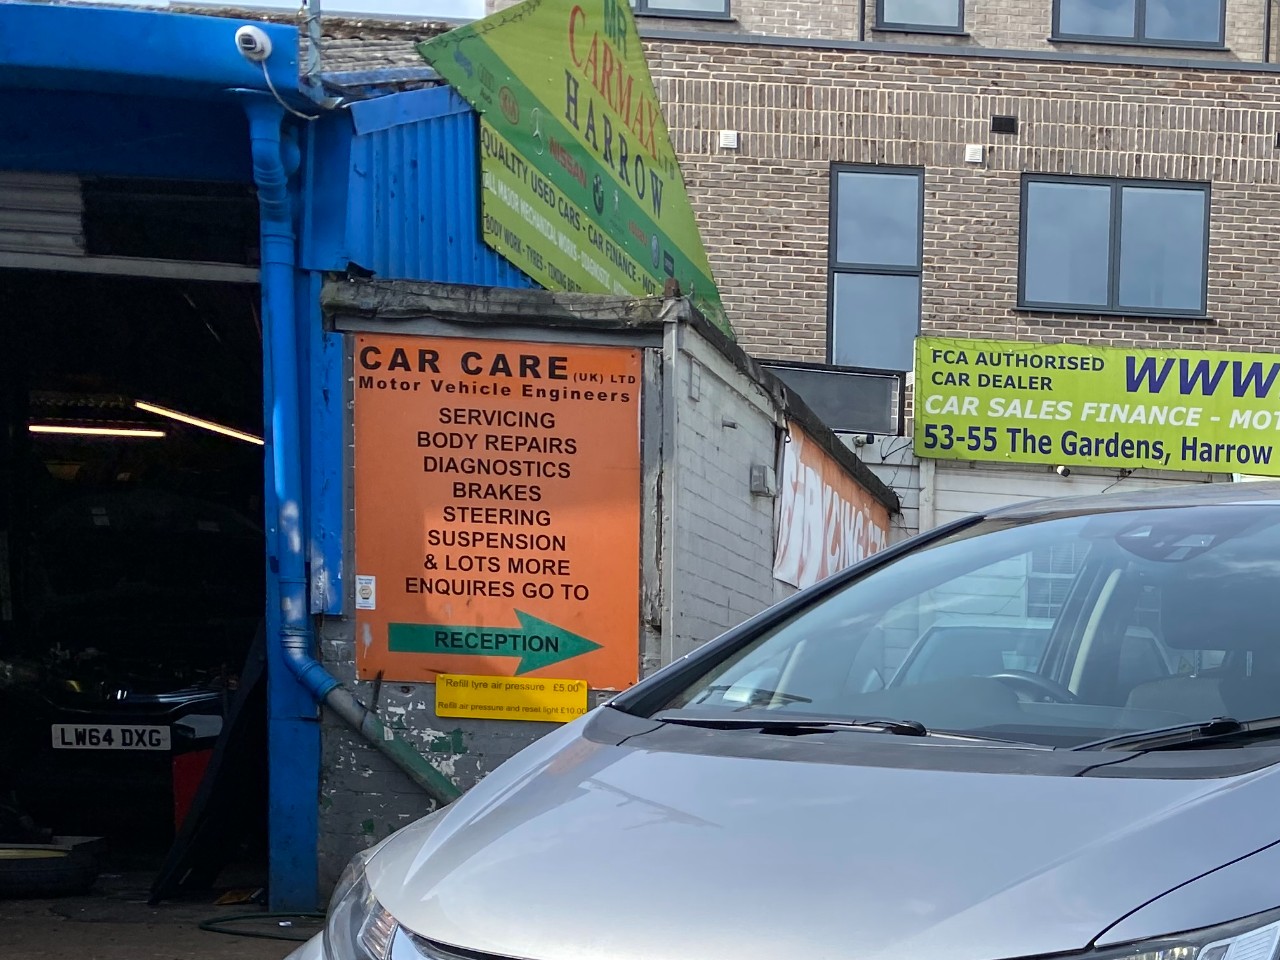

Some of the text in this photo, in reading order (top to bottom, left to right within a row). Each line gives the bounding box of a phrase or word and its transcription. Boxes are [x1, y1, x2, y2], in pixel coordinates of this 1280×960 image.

[569, 5, 658, 161] CARMAX
[565, 69, 664, 219] HARROW
[549, 137, 586, 188] NISSAN
[481, 127, 528, 184] QUALITY
[531, 173, 556, 208] USED
[558, 198, 581, 231] CARS
[588, 224, 603, 254] CAR
[606, 246, 636, 282] FINANCE
[486, 215, 502, 239] BODY
[359, 347, 636, 384] CAR CARE (UK) LTD
[932, 350, 1105, 372] FCA AUTHORISED
[359, 376, 631, 403] Motor Vehicle Engineers
[931, 371, 1053, 391] CAR DEALER
[439, 408, 556, 429] SERVICING
[925, 395, 983, 417] CAR
[987, 397, 1072, 422] SALES
[1081, 402, 1201, 427] FINANCE
[418, 432, 577, 454] BODY REPAIRS
[924, 424, 997, 452] 53-55
[1007, 427, 1052, 457] The
[1061, 431, 1172, 466] Gardens,
[1181, 436, 1273, 465] Harrow
[423, 456, 571, 478] DIAGNOSTICS
[453, 482, 541, 502] BRAKES
[443, 506, 551, 526] STEERING
[428, 530, 566, 552] SUSPENSION
[424, 555, 570, 576] & LOTS MORE
[406, 577, 589, 600] ENQUIRES GO TO
[435, 630, 559, 653] RECEPTION
[445, 678, 469, 688] Refill
[471, 680, 488, 690] tyre
[505, 683, 545, 692] pressure
[553, 684, 579, 693] £5.00
[470, 703, 503, 712] pressure
[60, 727, 162, 747] LW64 DXG
